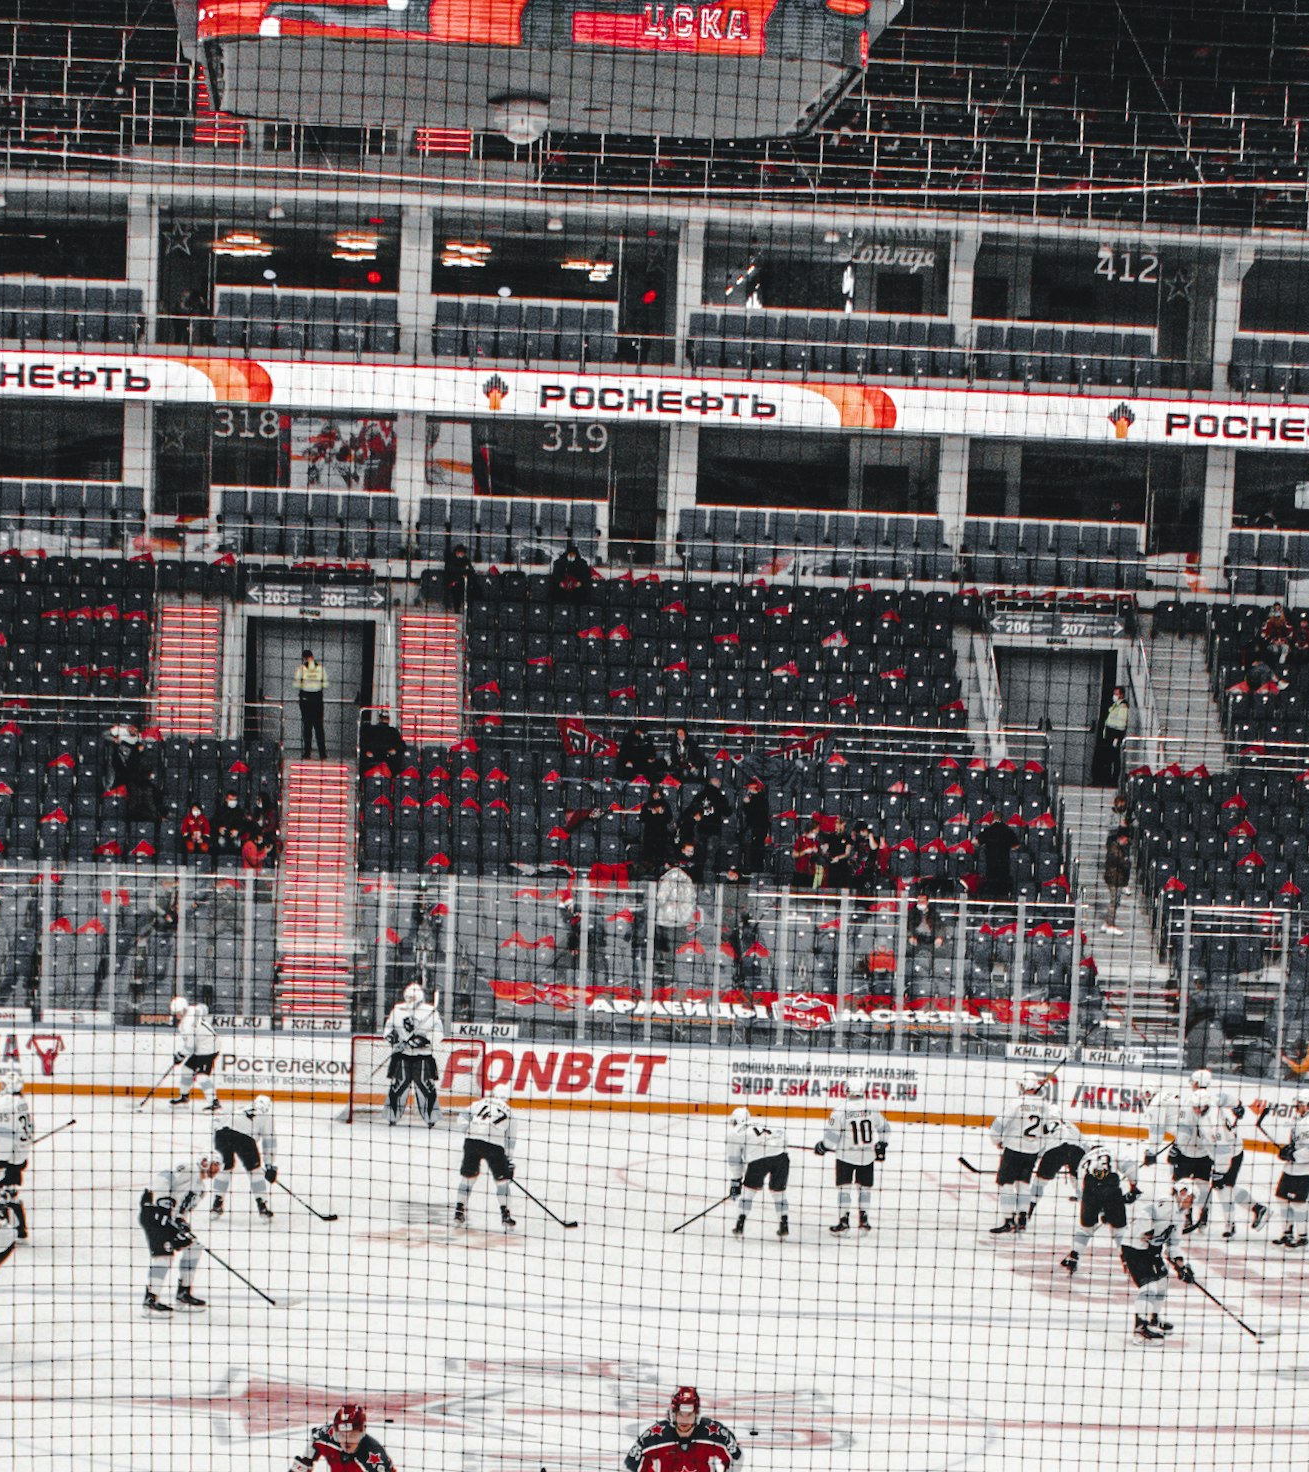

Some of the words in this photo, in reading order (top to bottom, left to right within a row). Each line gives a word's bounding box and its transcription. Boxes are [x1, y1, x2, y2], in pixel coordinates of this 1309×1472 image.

[643, 3, 749, 41] ЦСКА
[539, 384, 777, 419] РОСНЕФТЬ
[213, 408, 280, 438] 318
[541, 423, 608, 453] 319
[1005, 621, 1031, 635] 206
[1061, 623, 1086, 636] 207
[459, 1024, 510, 1037] KHL.RU
[1014, 1045, 1063, 1059] KHL.RU
[440, 1048, 668, 1095] FONBET
[850, 1119, 873, 1145] 10
